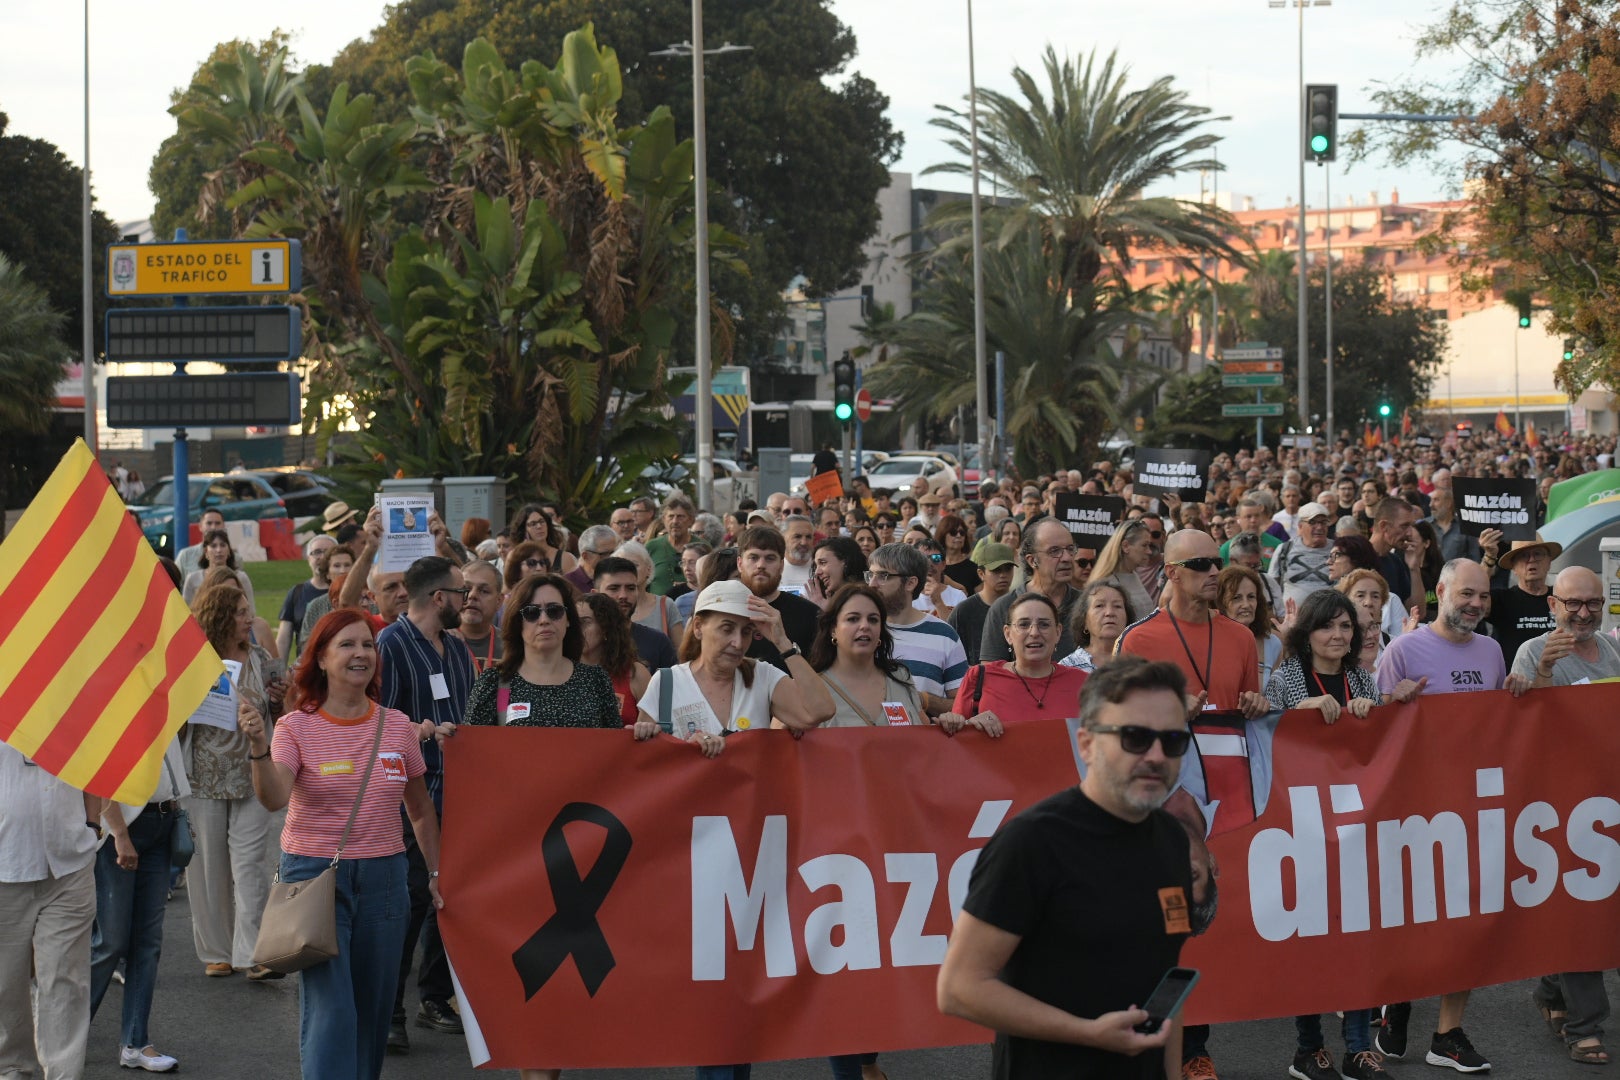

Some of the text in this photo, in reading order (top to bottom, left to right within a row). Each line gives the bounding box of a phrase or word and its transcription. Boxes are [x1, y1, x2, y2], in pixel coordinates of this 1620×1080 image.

[146, 253, 243, 268] ESTADO DEL
[161, 270, 228, 283] TRAFICO
[1146, 461, 1197, 476] MAZÓN
[1139, 473, 1202, 489] DIMISSIÓ
[1464, 492, 1521, 509] MAZÓN
[1067, 508, 1111, 523] MAZÓN
[1460, 508, 1529, 525] DIMISSIÓ
[1450, 670, 1484, 685] 25N
